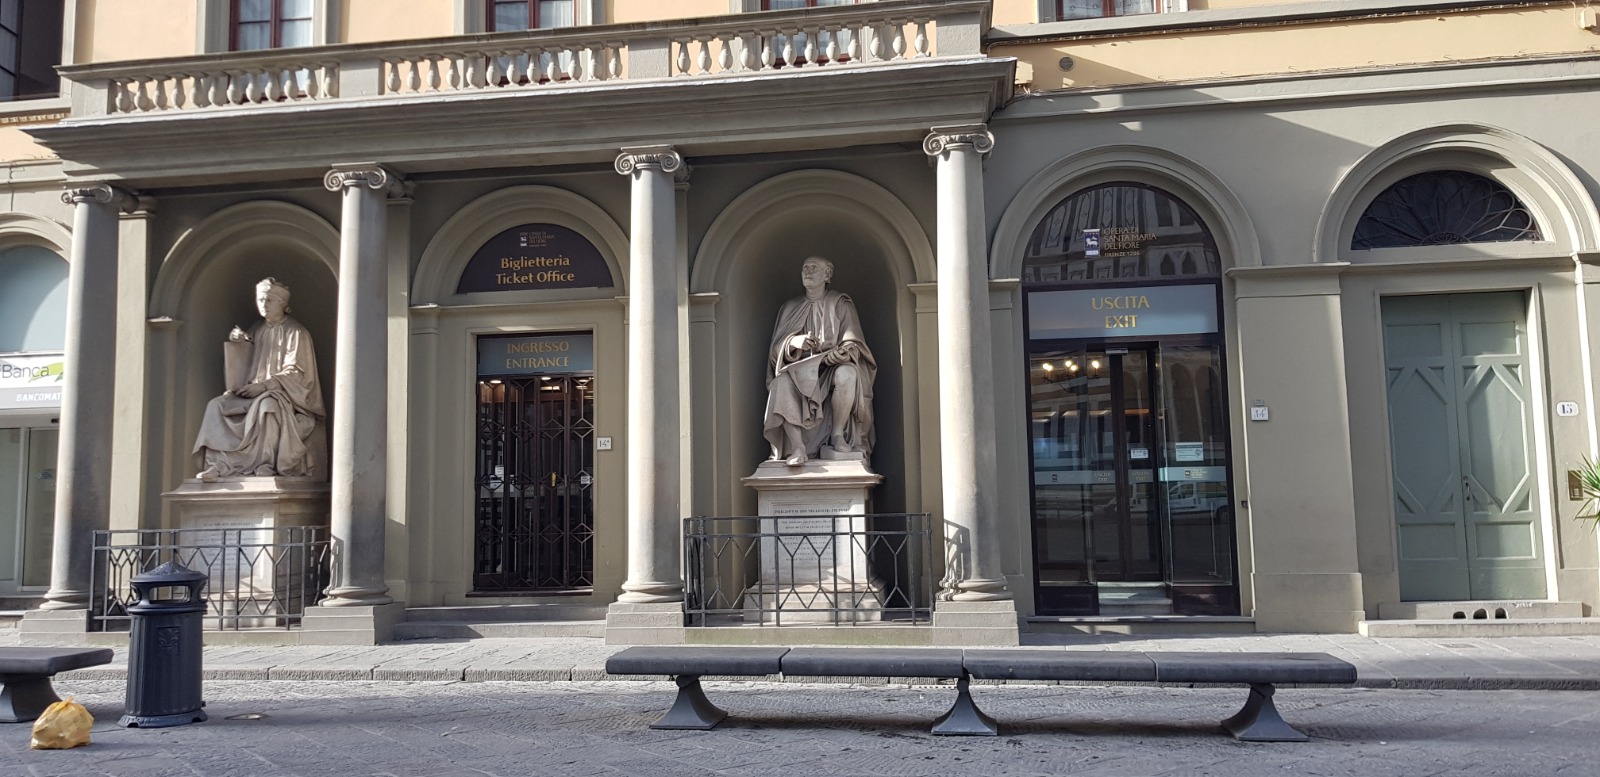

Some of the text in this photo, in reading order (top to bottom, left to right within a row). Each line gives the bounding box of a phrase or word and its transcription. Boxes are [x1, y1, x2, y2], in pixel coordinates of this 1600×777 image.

[1103, 226, 1139, 235] OPERA DI
[1131, 233, 1157, 241] MARIA
[1103, 241, 1140, 250] DEL FIORE
[501, 255, 570, 270] Biglietteria
[496, 270, 575, 285] Ticket Office
[1092, 295, 1150, 310] USCITA
[1105, 314, 1138, 329] EXIT
[507, 342, 569, 354] INGRESSO
[506, 356, 570, 369] ENTRANCE
[16, 392, 62, 402] BANCOMAT
[1561, 404, 1573, 414] 15
